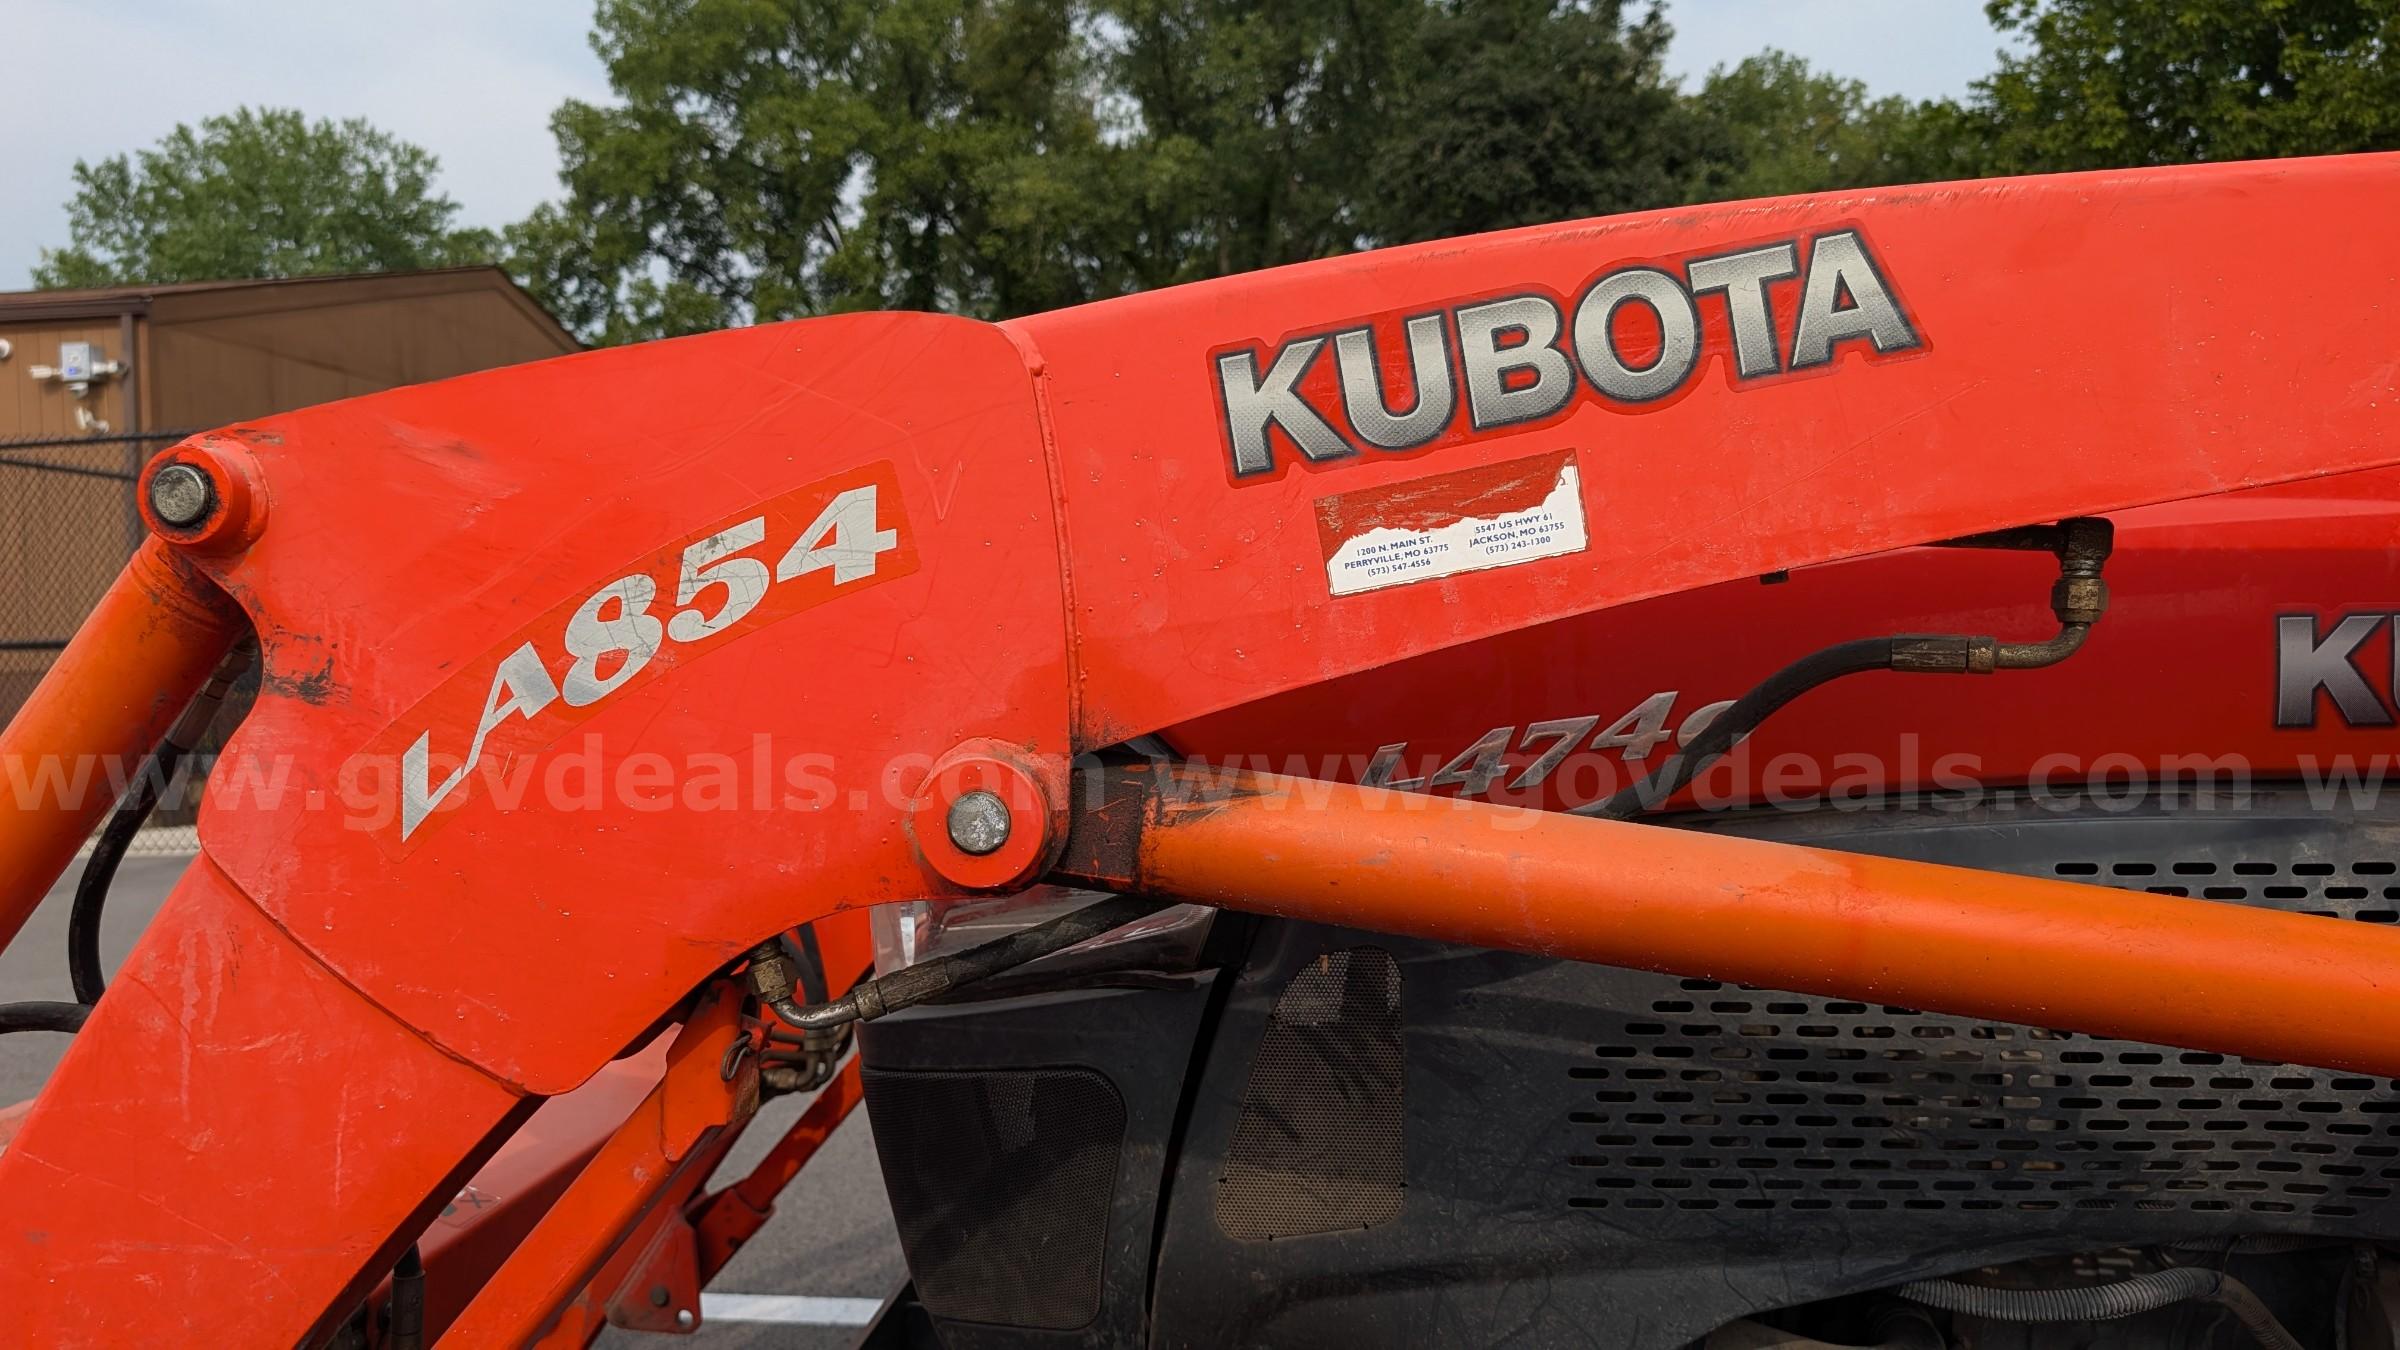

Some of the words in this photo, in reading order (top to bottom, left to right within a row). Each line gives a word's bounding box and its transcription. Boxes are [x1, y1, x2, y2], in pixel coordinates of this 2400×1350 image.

[1217, 228, 1923, 476] KUBOTA
[1469, 531, 1519, 548] JACKSON,
[1520, 527, 1536, 537] MO
[1539, 521, 1565, 533] 63755
[1475, 523, 1496, 534] 5547
[1499, 520, 1513, 530] US
[1515, 515, 1540, 527] HWY
[1543, 512, 1553, 521] 61
[1344, 552, 1403, 570] PERRYVILLE,
[1404, 549, 1421, 559] MO
[1423, 543, 1449, 555] 63775
[1356, 546, 1376, 557] 1200
[1378, 544, 1390, 553] N.
[1390, 538, 1416, 550] MAIN
[1419, 535, 1433, 545] ST.
[1486, 543, 1509, 555] (573)
[1511, 535, 1551, 550] 243-1300
[1367, 565, 1390, 578] (573)
[1392, 558, 1431, 572] 547-4556
[403, 484, 898, 843] LA854
[2276, 613, 2400, 729] K
